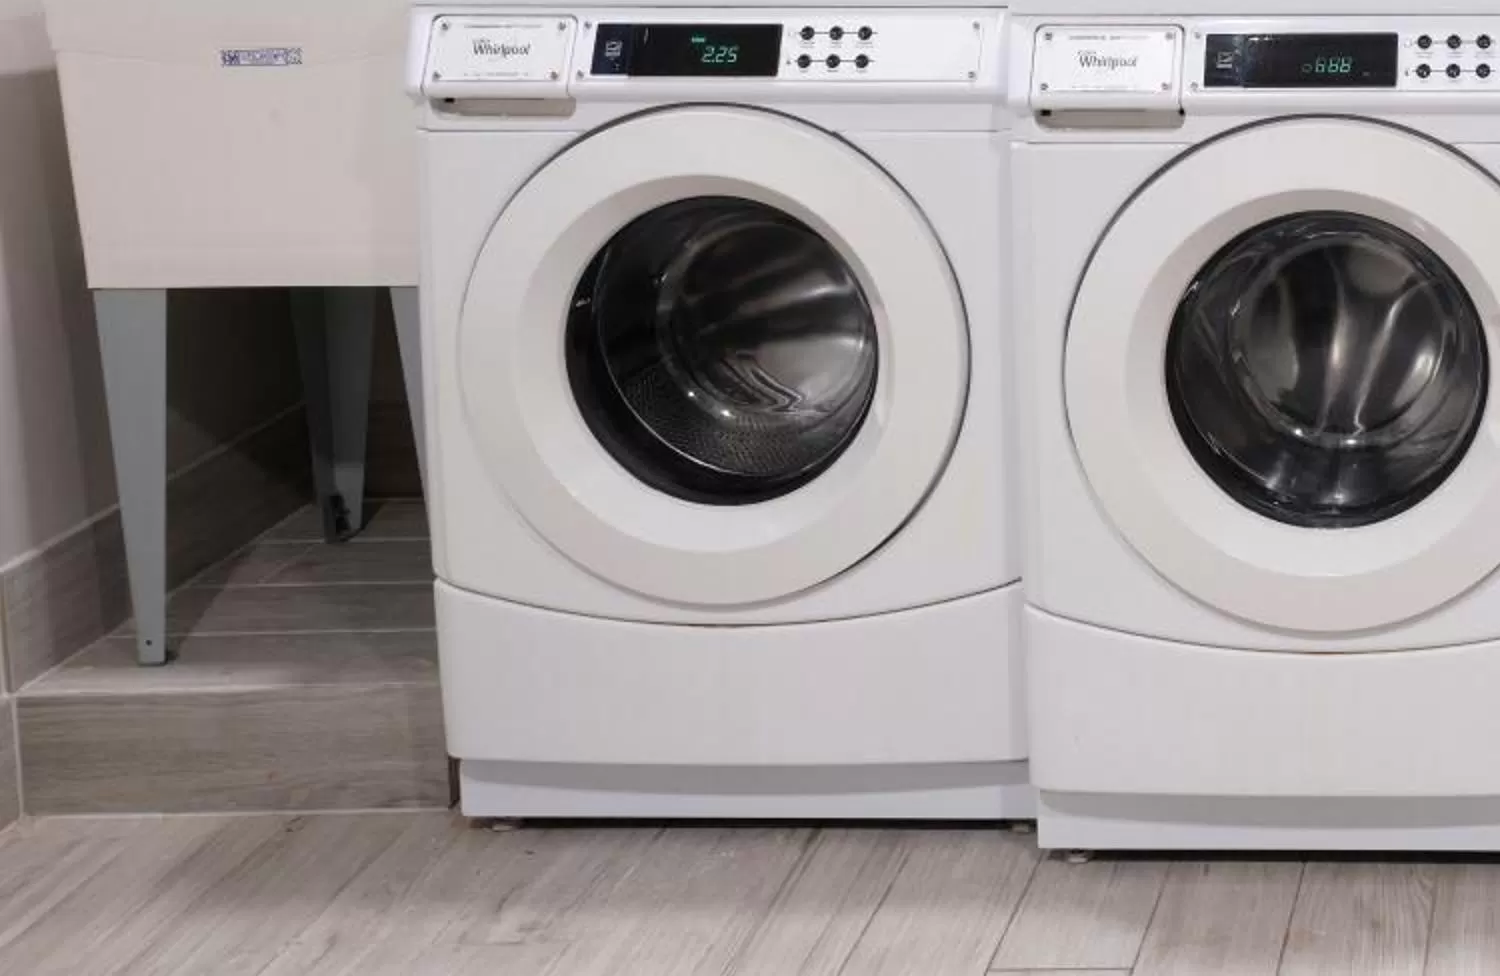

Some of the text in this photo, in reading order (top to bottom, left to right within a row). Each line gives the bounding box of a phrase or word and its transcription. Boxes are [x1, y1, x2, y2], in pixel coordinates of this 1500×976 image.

[472, 40, 531, 58] Whirlpool
[701, 45, 740, 63] 2.25
[1078, 54, 1138, 70] Whirlpool
